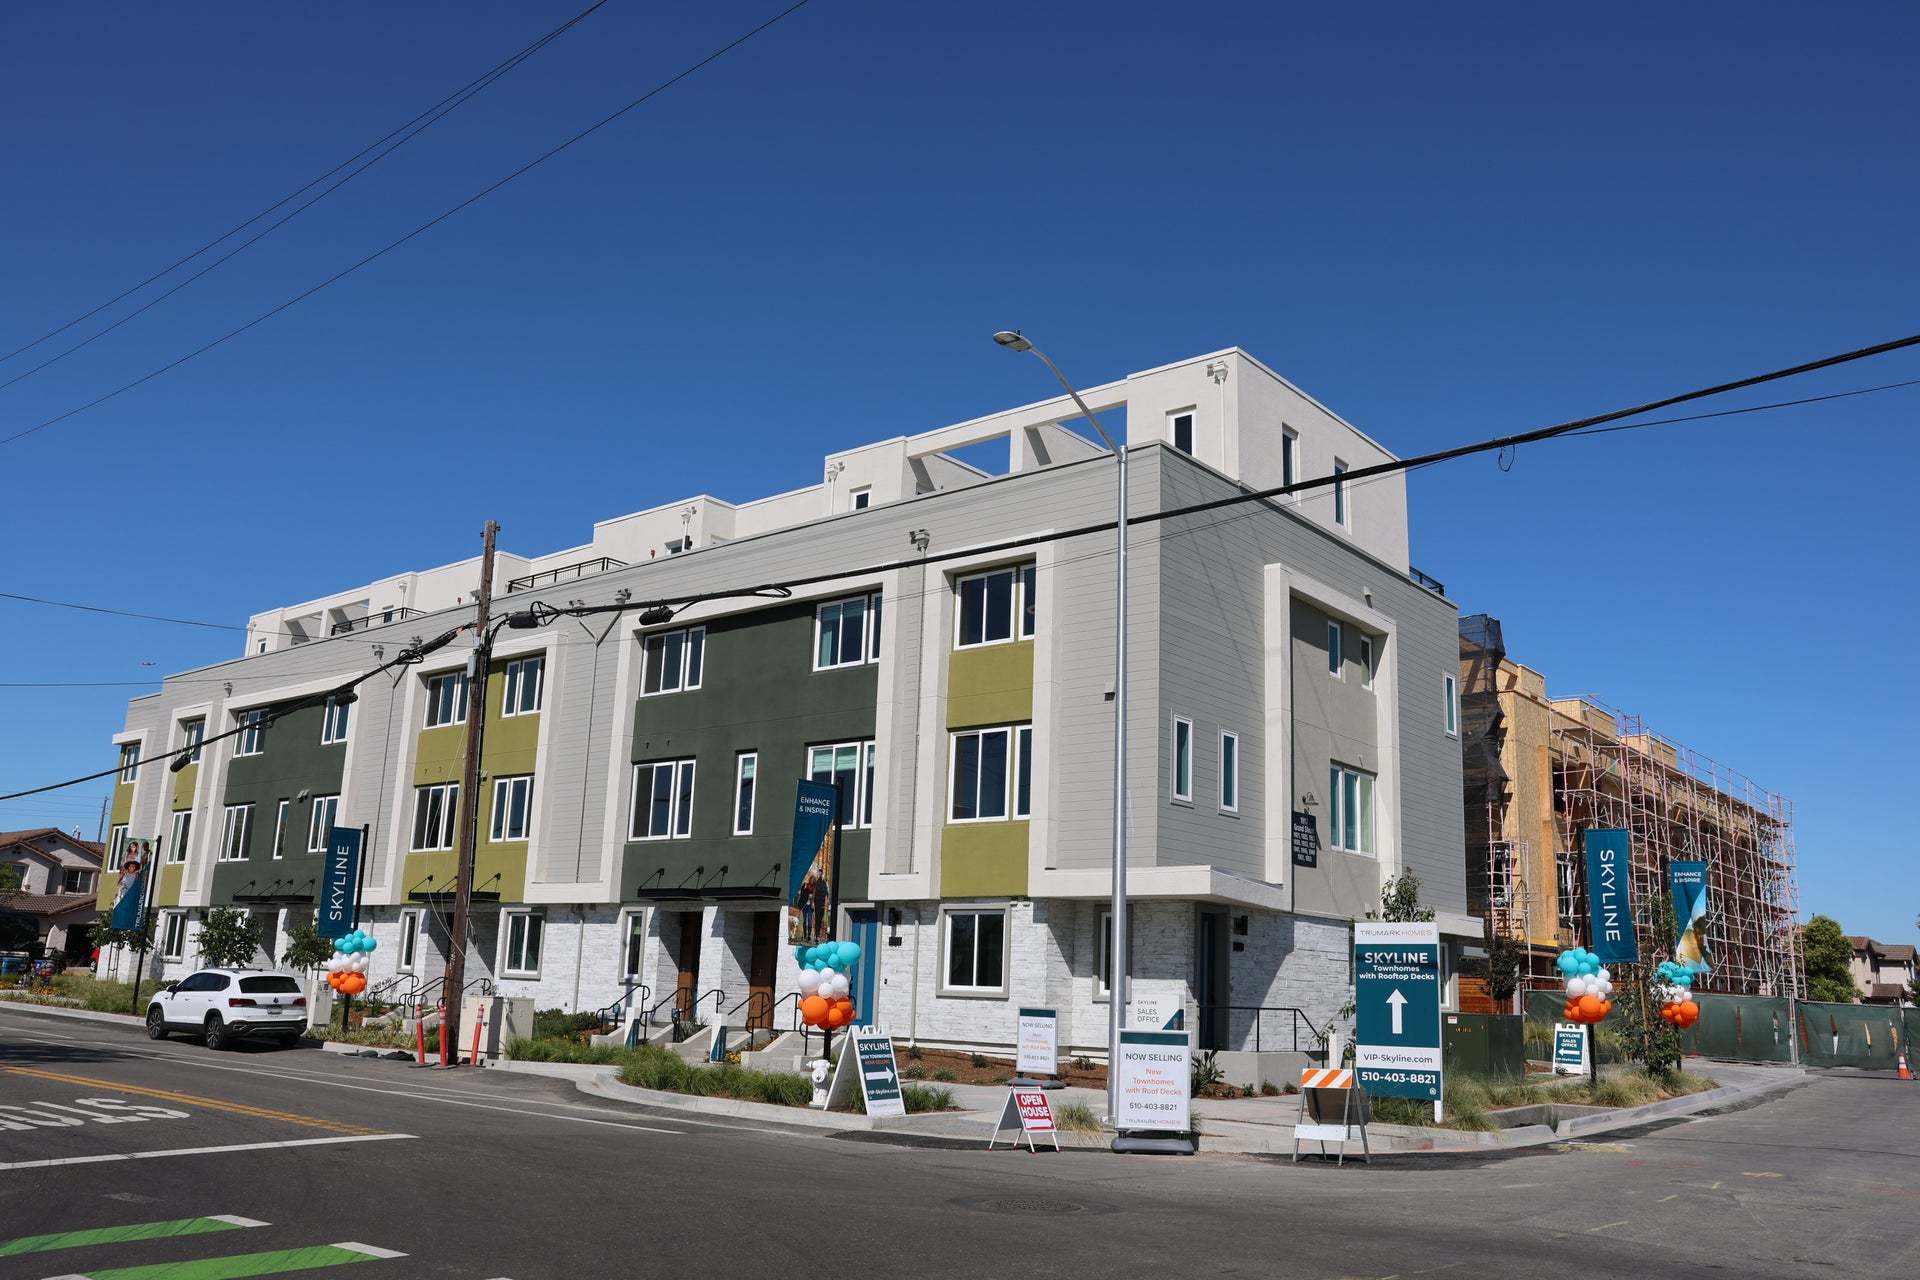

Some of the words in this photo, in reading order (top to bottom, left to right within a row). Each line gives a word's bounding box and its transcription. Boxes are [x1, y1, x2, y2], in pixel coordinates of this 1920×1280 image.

[800, 797, 831, 807] ENHANCE
[805, 806, 829, 815] INSPIRE
[329, 845, 350, 921] SKYLINE
[1600, 849, 1621, 942] SKYLINE
[1364, 952, 1429, 964] SKYLINE
[1359, 972, 1376, 980] with
[1378, 972, 1409, 981] Rooftop
[1410, 973, 1435, 981] Decks
[1137, 1008, 1158, 1016] SALES
[1137, 1016, 1160, 1024] OFFICE
[859, 1043, 889, 1051] SKYLINE
[1125, 1053, 1147, 1061] NOW
[1148, 1053, 1183, 1062] SELLING
[1364, 1053, 1433, 1064] VIP-Skyline.com
[1145, 1068, 1162, 1076] New
[1133, 1078, 1175, 1086] Townhomes
[1361, 1071, 1436, 1085] 510-403-8821
[1125, 1087, 1141, 1095] with
[1142, 1087, 1158, 1095] Roof
[1159, 1088, 1182, 1096] Decks
[1021, 1095, 1043, 1106] OPEN
[1129, 1102, 1178, 1111] 510-403-8821
[1021, 1106, 1049, 1117] HOUSE
